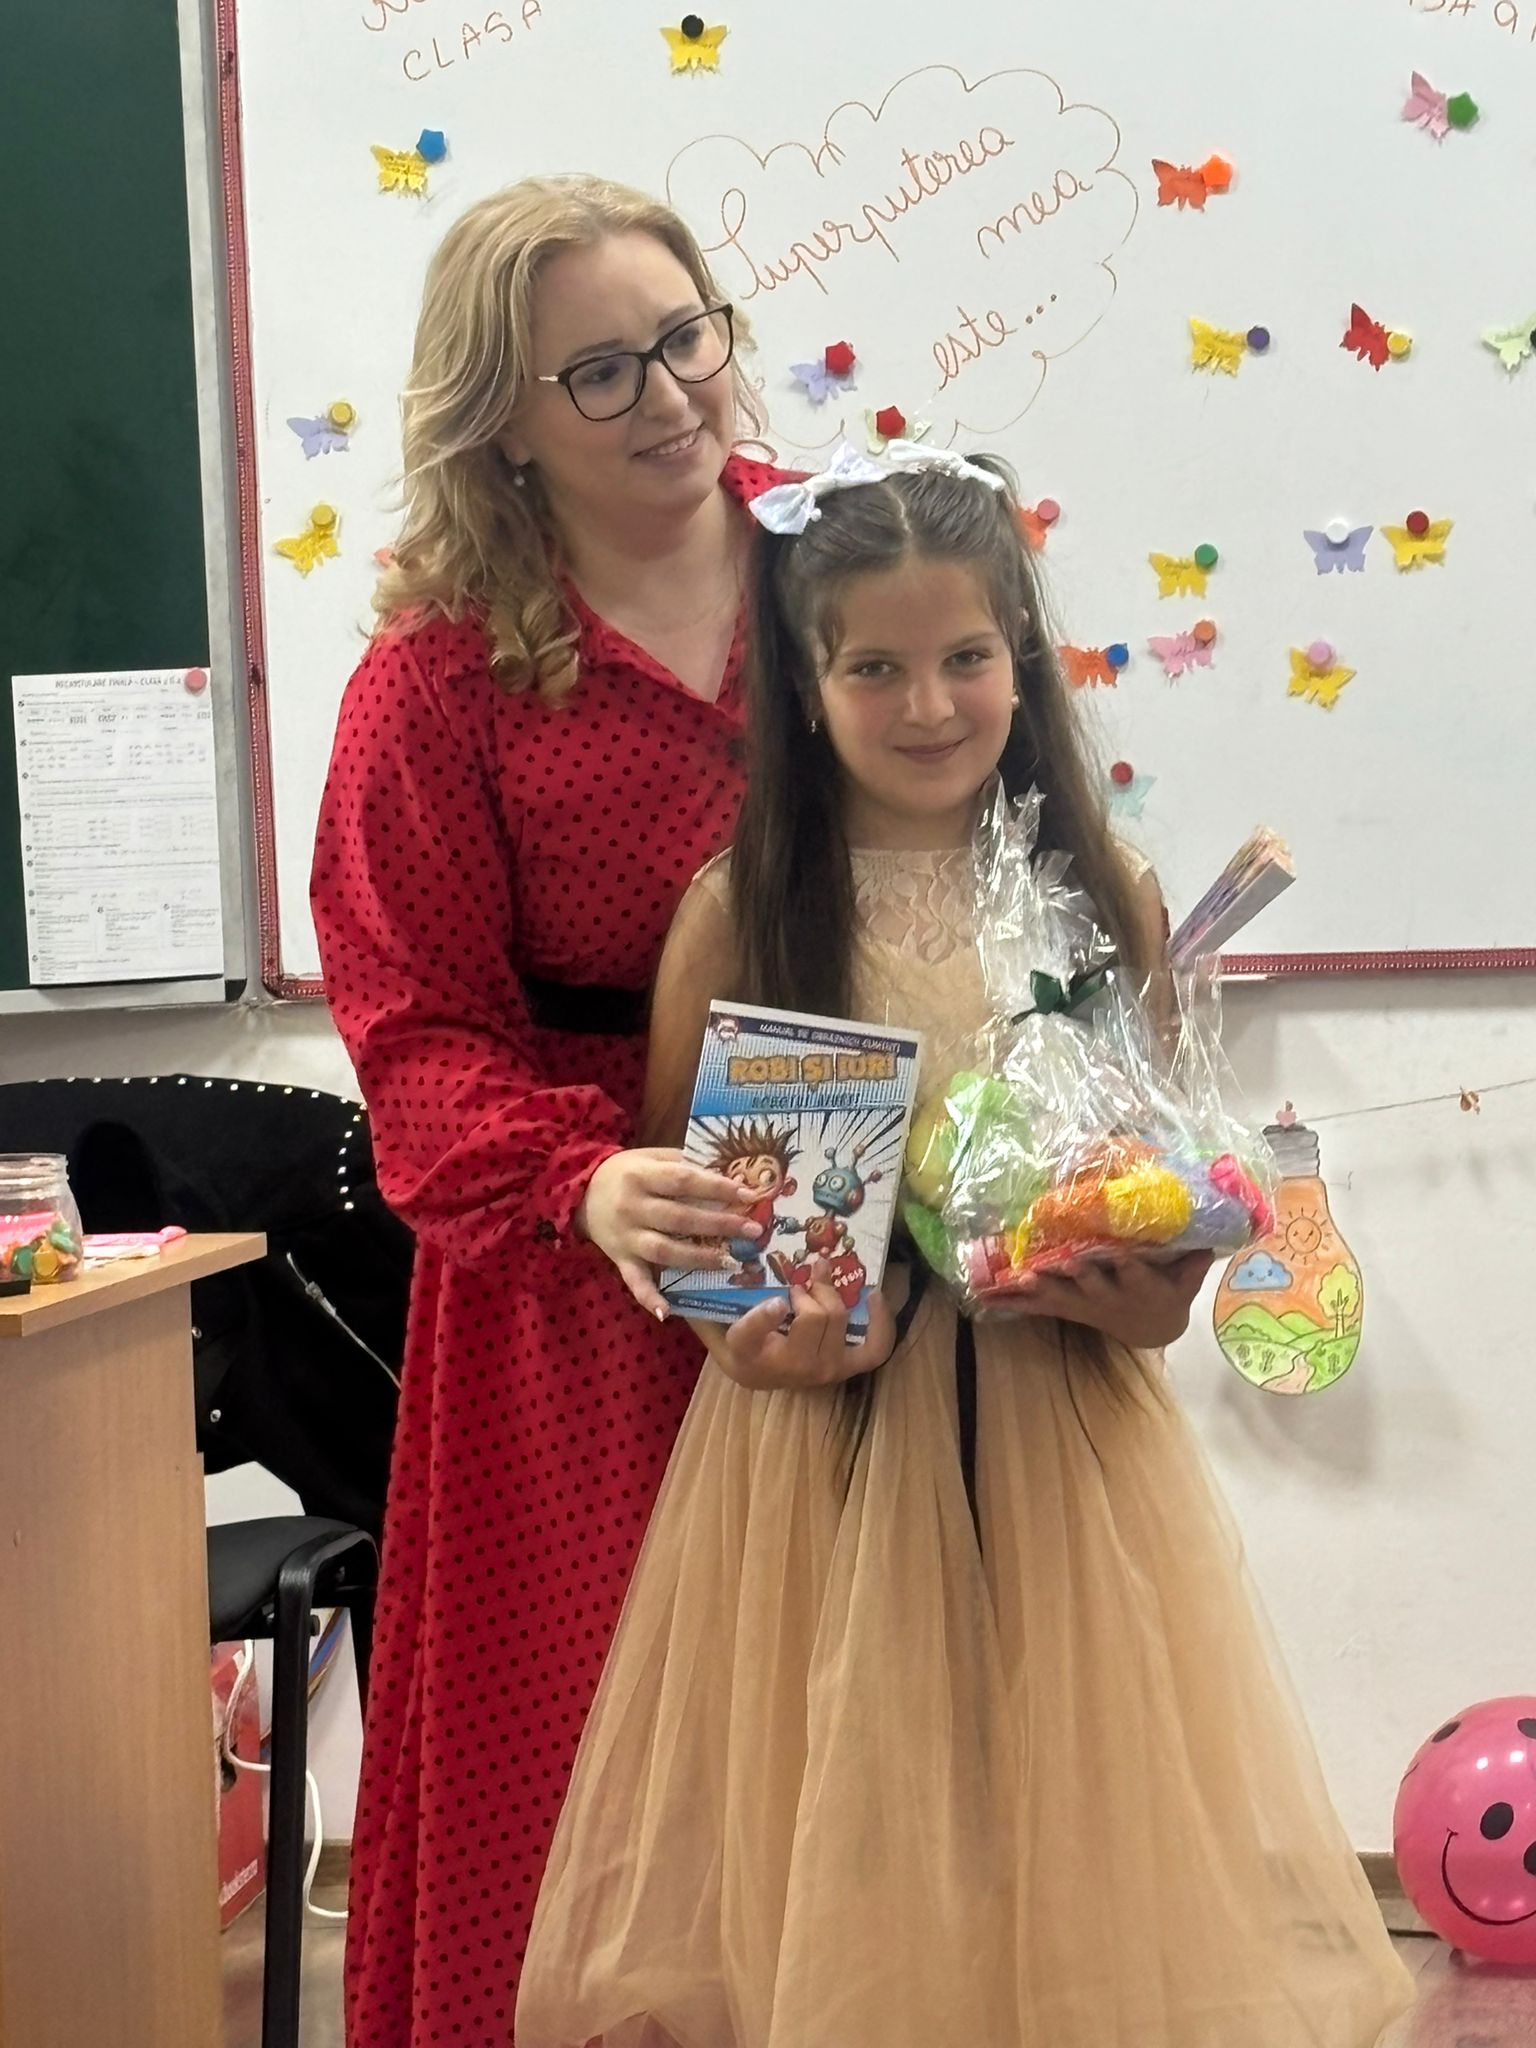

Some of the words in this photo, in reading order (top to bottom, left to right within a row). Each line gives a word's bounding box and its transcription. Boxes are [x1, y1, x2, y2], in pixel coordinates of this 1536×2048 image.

[402, 0, 542, 81] CLASA
[703, 127, 1014, 300] Superputerea
[977, 169, 1094, 259] mea
